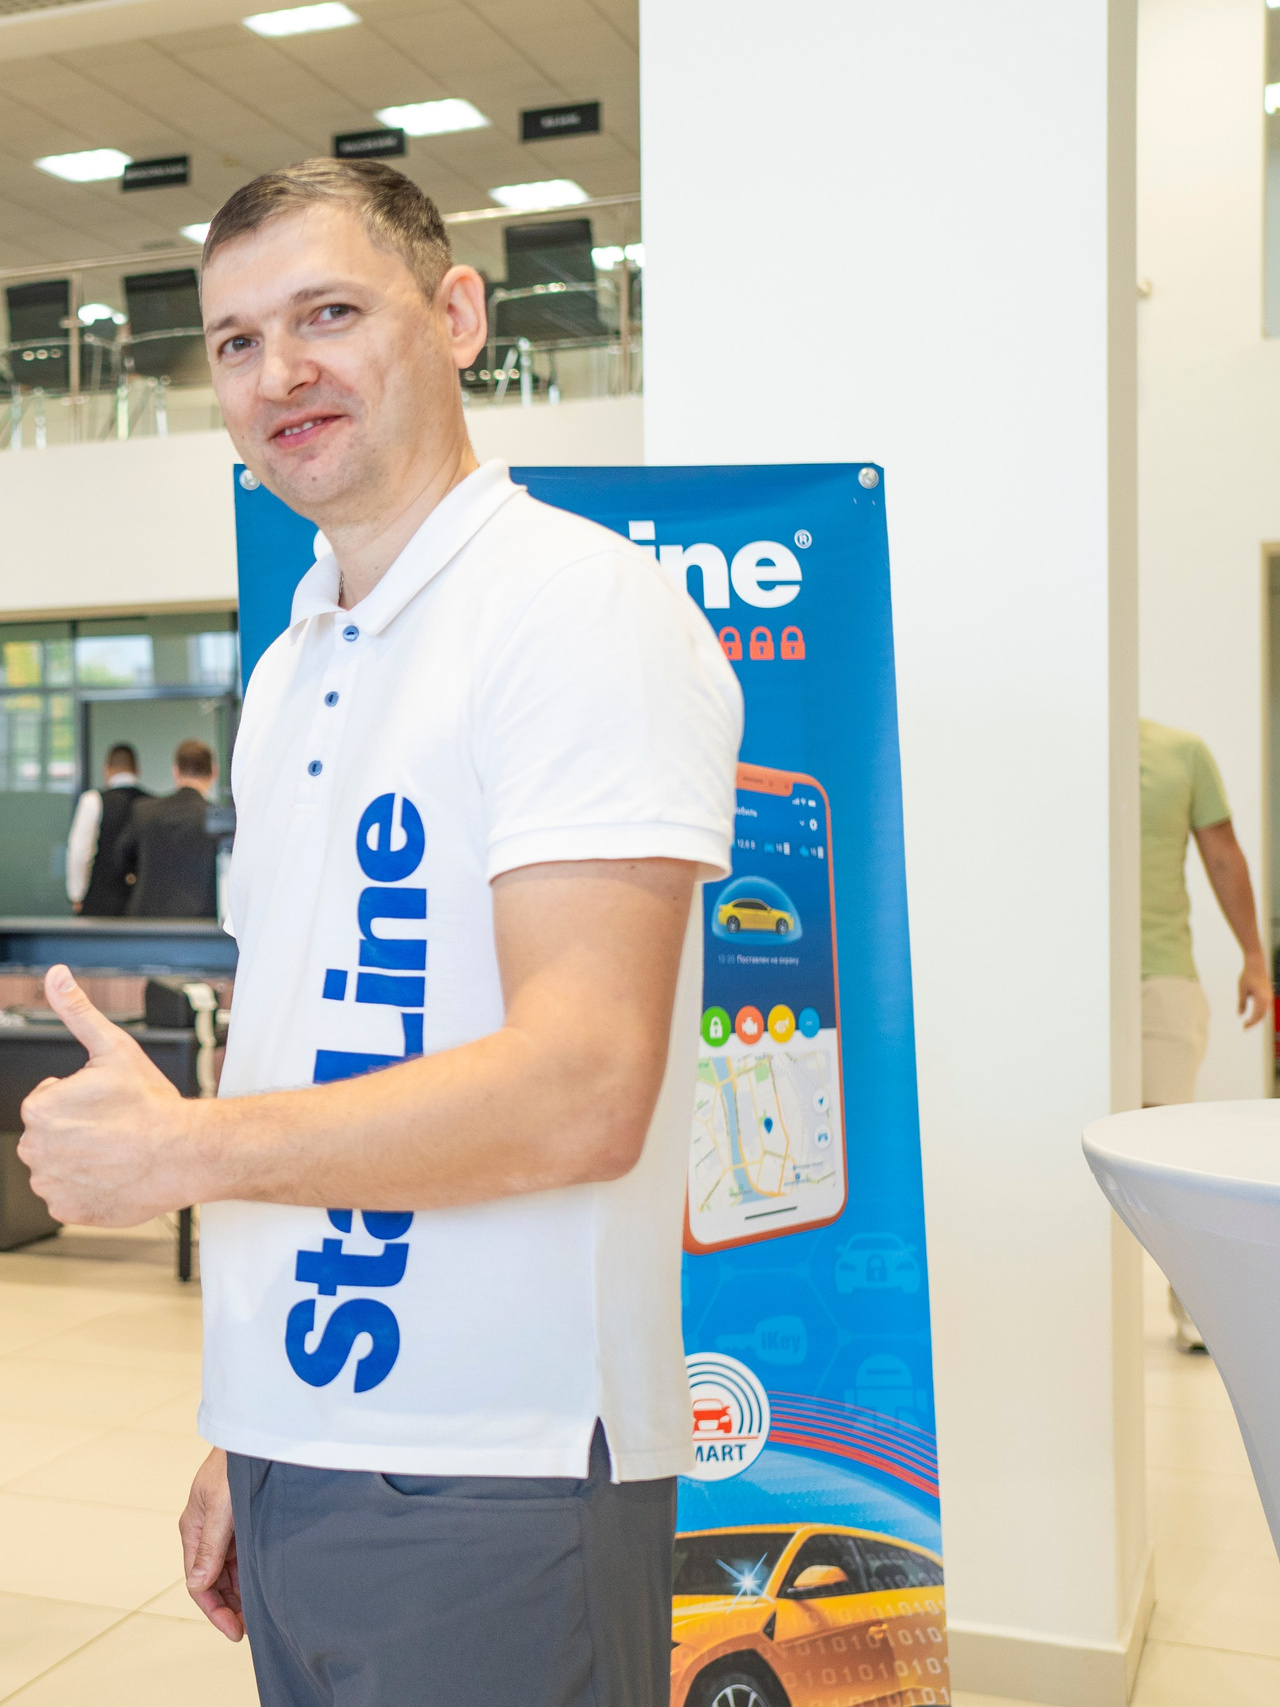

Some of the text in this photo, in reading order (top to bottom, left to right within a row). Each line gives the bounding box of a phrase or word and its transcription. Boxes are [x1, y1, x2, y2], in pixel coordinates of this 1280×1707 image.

[285, 792, 427, 1393] StLine
[761, 1330, 801, 1354] iKey
[695, 1443, 747, 1462] MART
